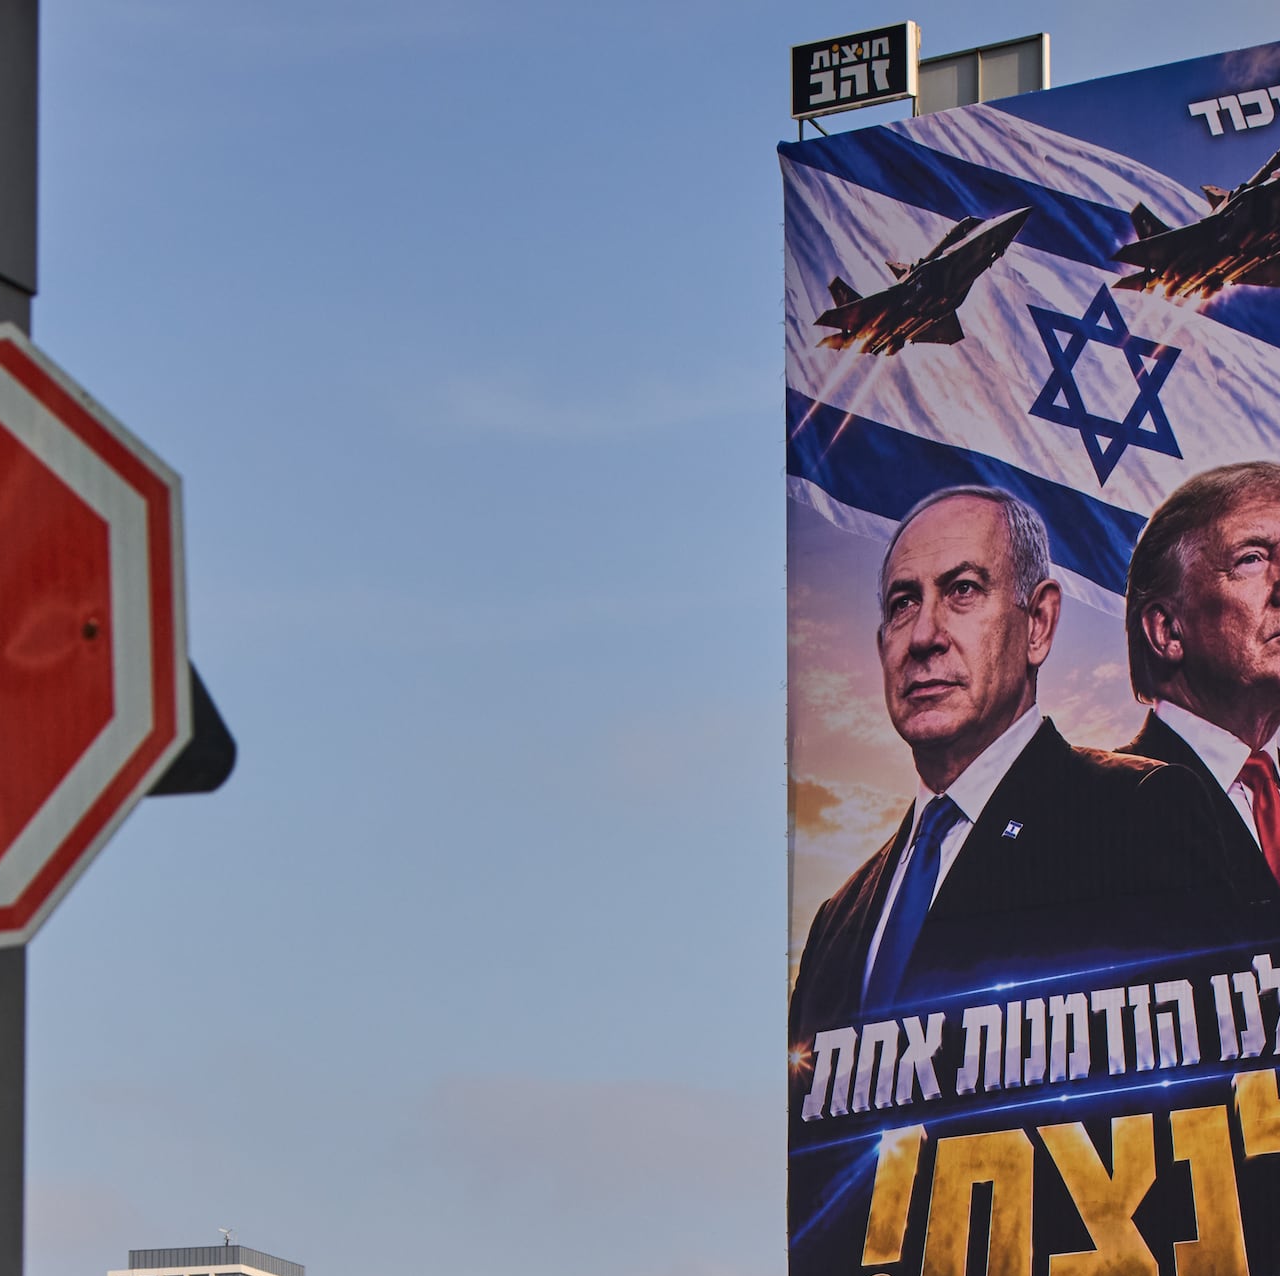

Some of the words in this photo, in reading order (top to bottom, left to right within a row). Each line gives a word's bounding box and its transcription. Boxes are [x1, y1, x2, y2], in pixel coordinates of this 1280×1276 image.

[809, 58, 890, 105] זהב
[810, 36, 890, 71] חוצות
[801, 1012, 946, 1122] אחת
[956, 978, 1202, 1096] הזדמנות
